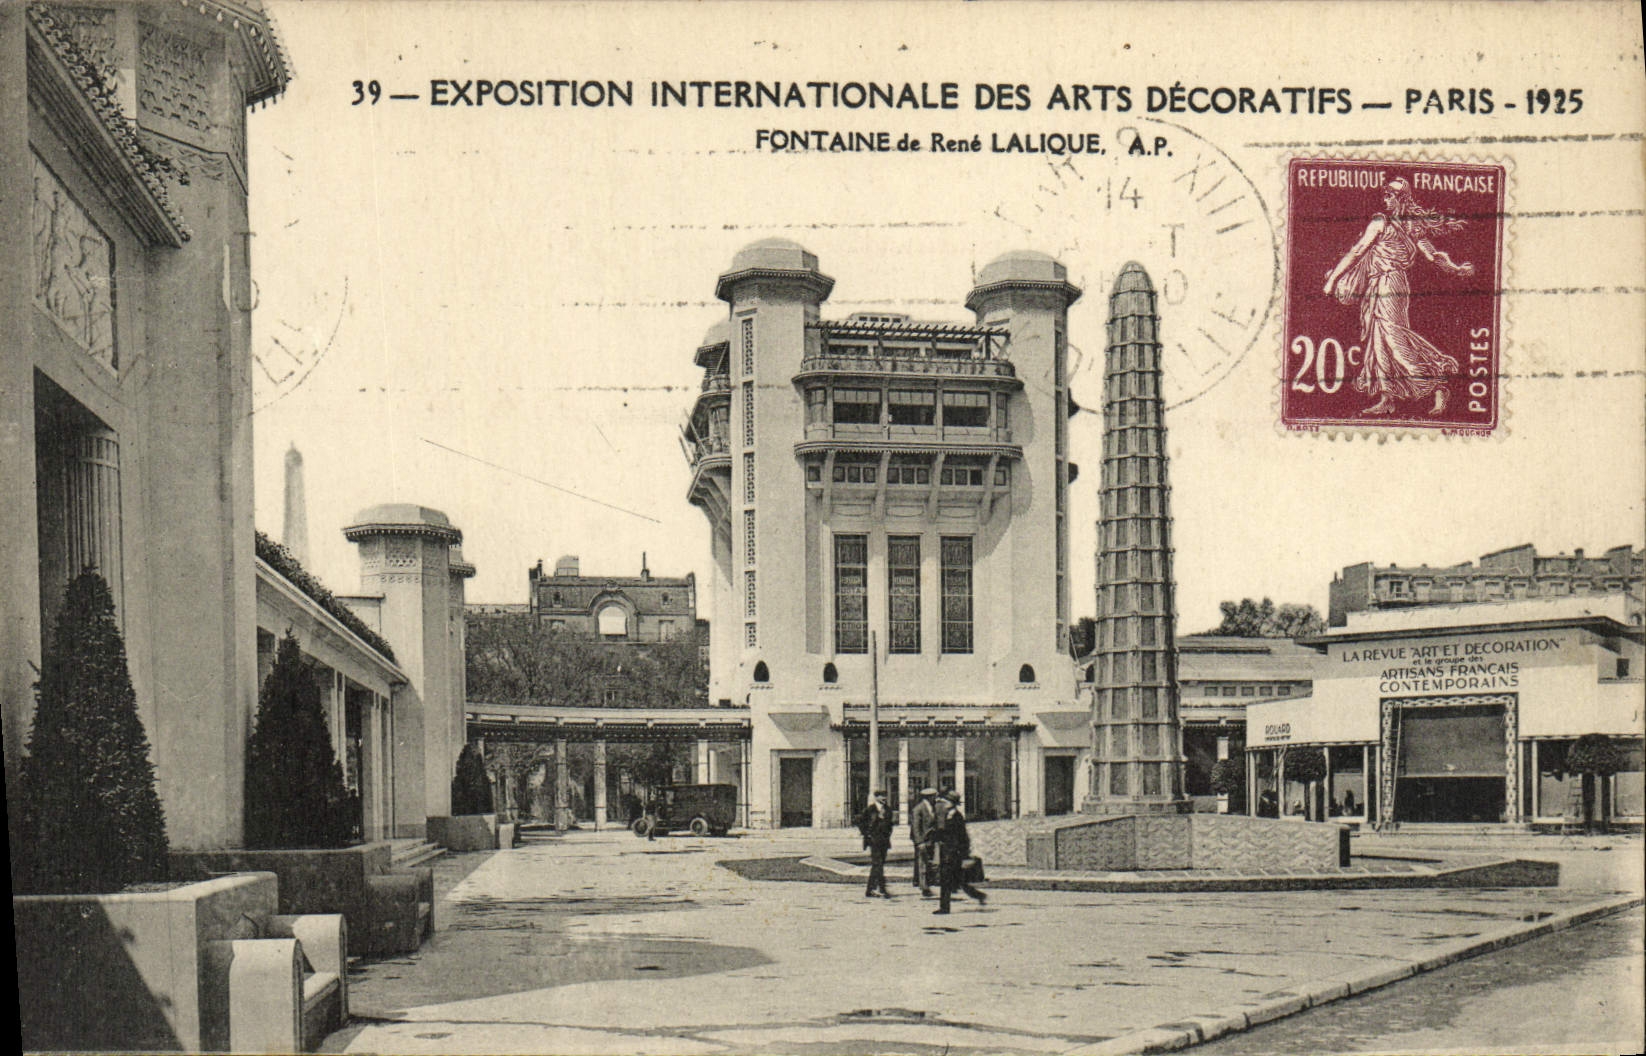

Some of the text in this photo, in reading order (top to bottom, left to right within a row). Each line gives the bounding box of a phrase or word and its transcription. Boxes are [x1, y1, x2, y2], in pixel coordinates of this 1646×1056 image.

[1414, 173, 1494, 194] FRANÇAISE
[1468, 327, 1490, 413] POSTES
[1343, 651, 1360, 662] LA
[1363, 648, 1406, 660] REVUE
[1443, 644, 1459, 656] ET
[1435, 656, 1464, 665] groupe
[1380, 666, 1444, 680] ARTISANS
[1380, 675, 1519, 693] CONTEMPORAINS
